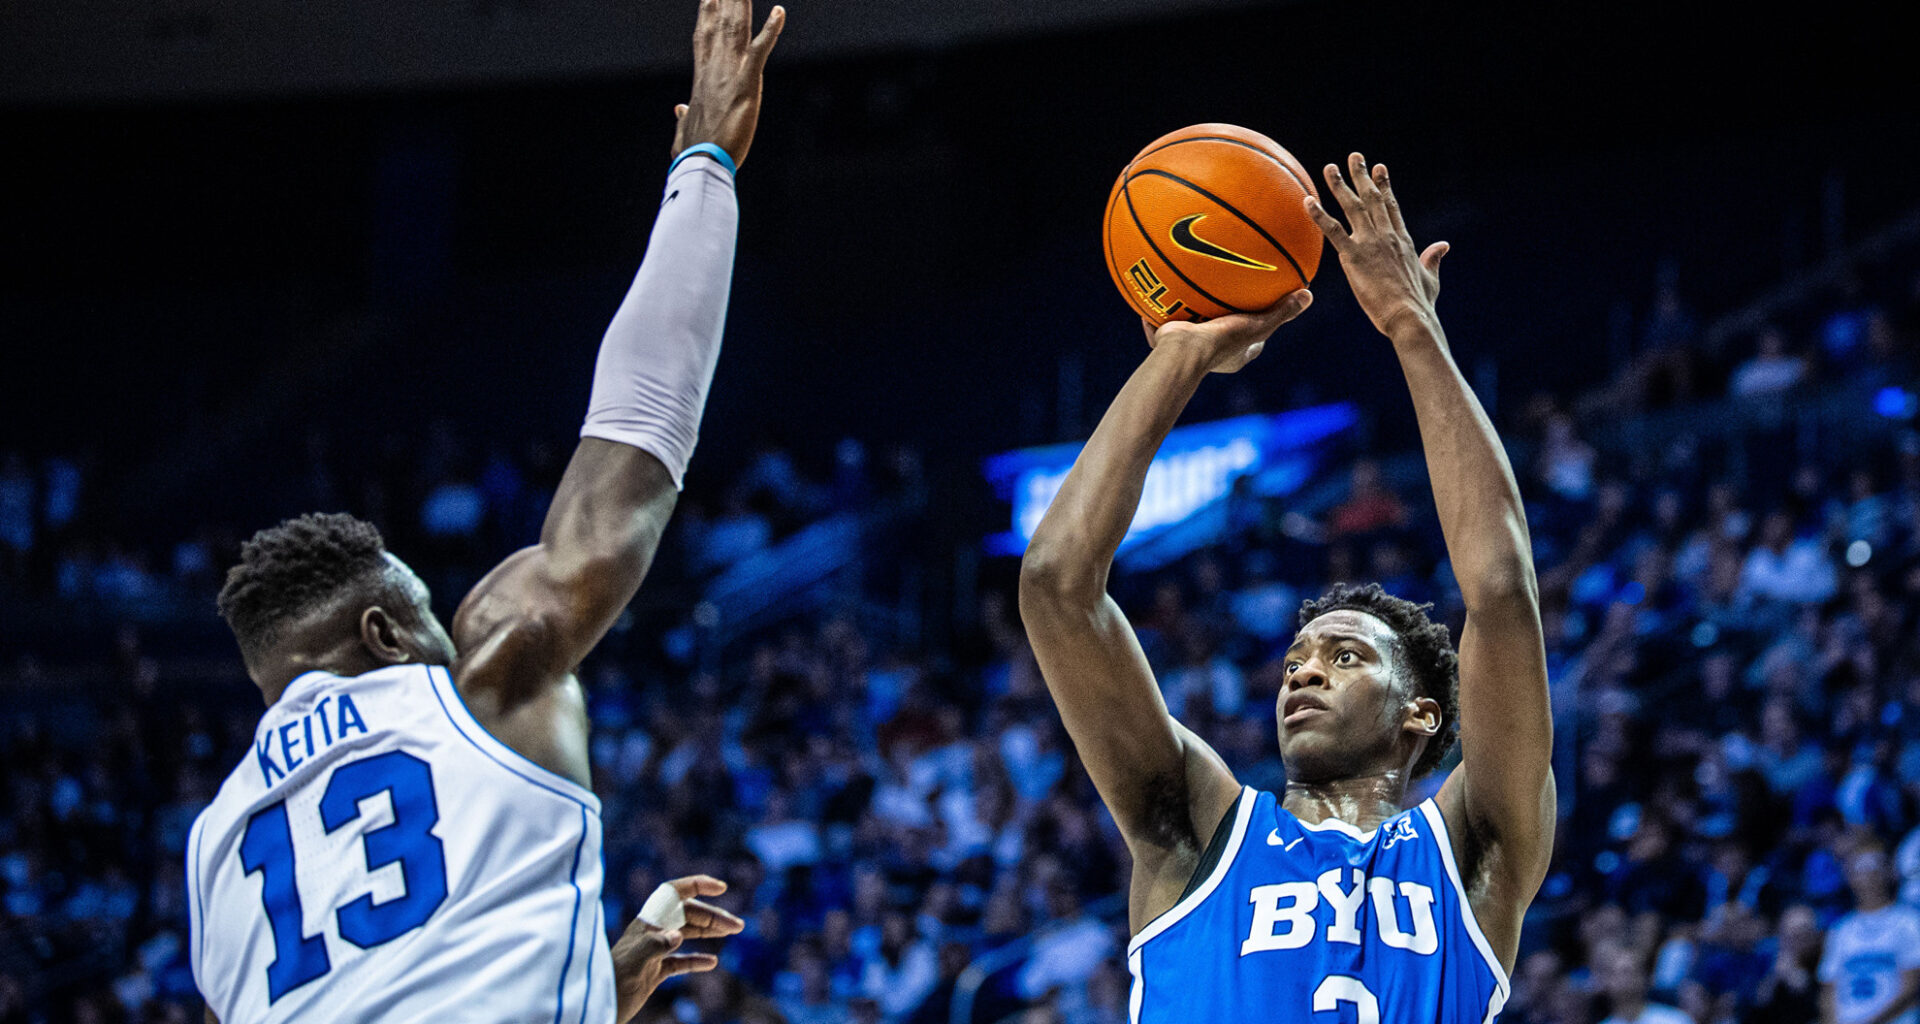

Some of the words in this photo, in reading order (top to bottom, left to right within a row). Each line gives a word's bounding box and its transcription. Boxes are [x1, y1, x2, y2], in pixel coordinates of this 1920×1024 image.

[257, 694, 368, 788] KEITA
[239, 748, 448, 1007] 13
[1240, 867, 1438, 957] BYU
